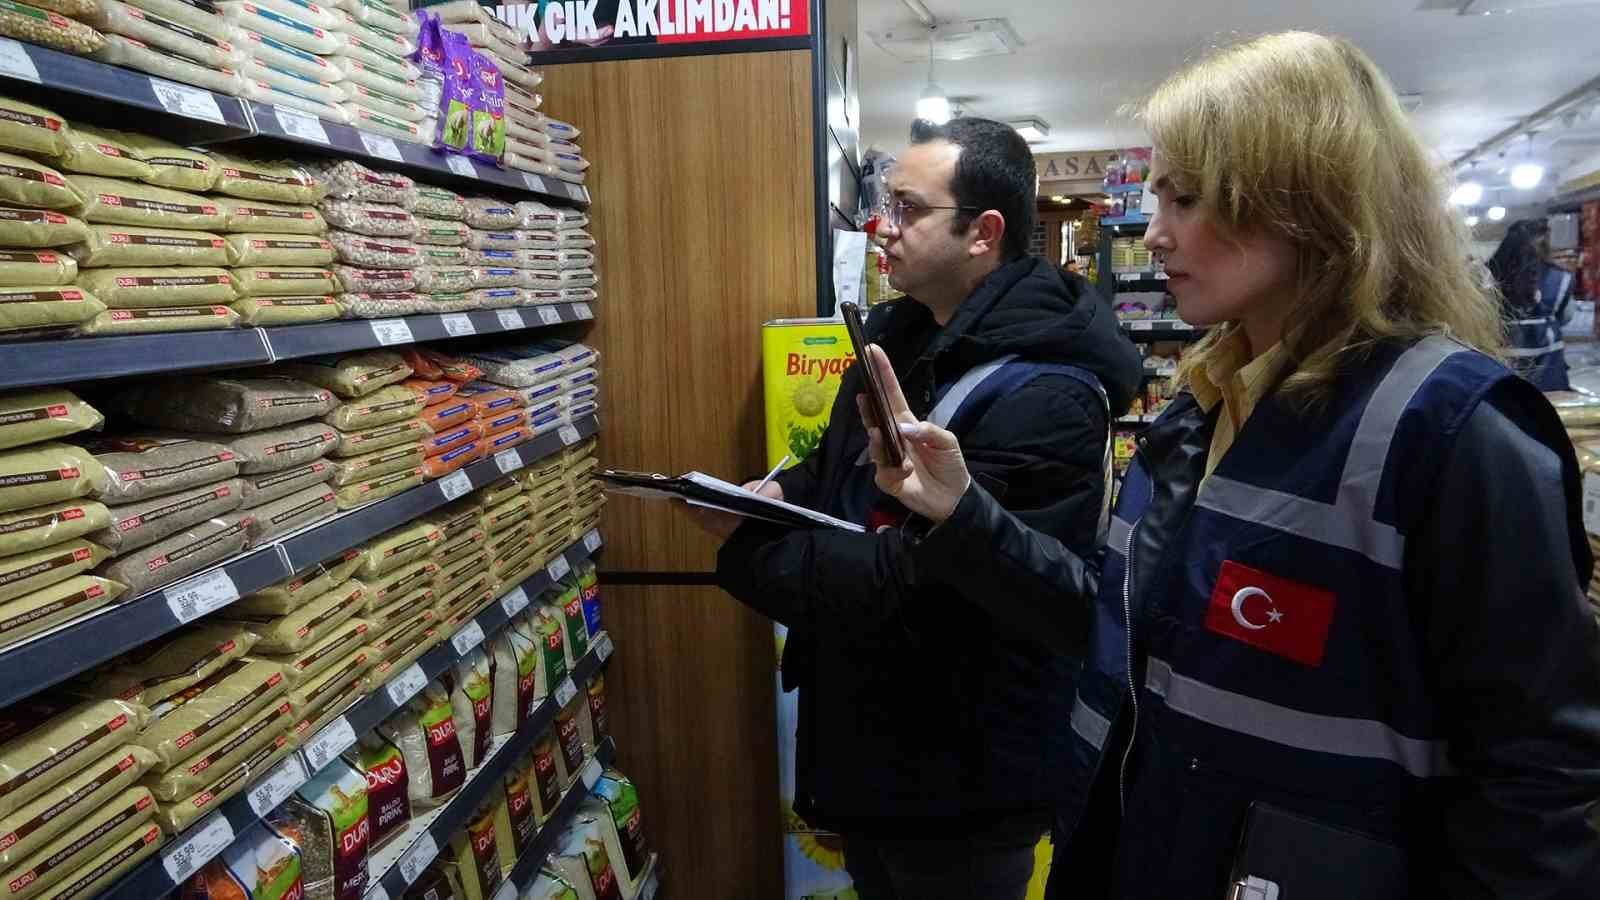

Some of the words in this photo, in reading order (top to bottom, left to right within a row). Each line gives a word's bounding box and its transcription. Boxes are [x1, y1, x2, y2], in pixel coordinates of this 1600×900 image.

[545, 0, 600, 44] ÇIK
[614, 0, 791, 37] AKLIMDAN!
[366, 760, 402, 790] DURU
